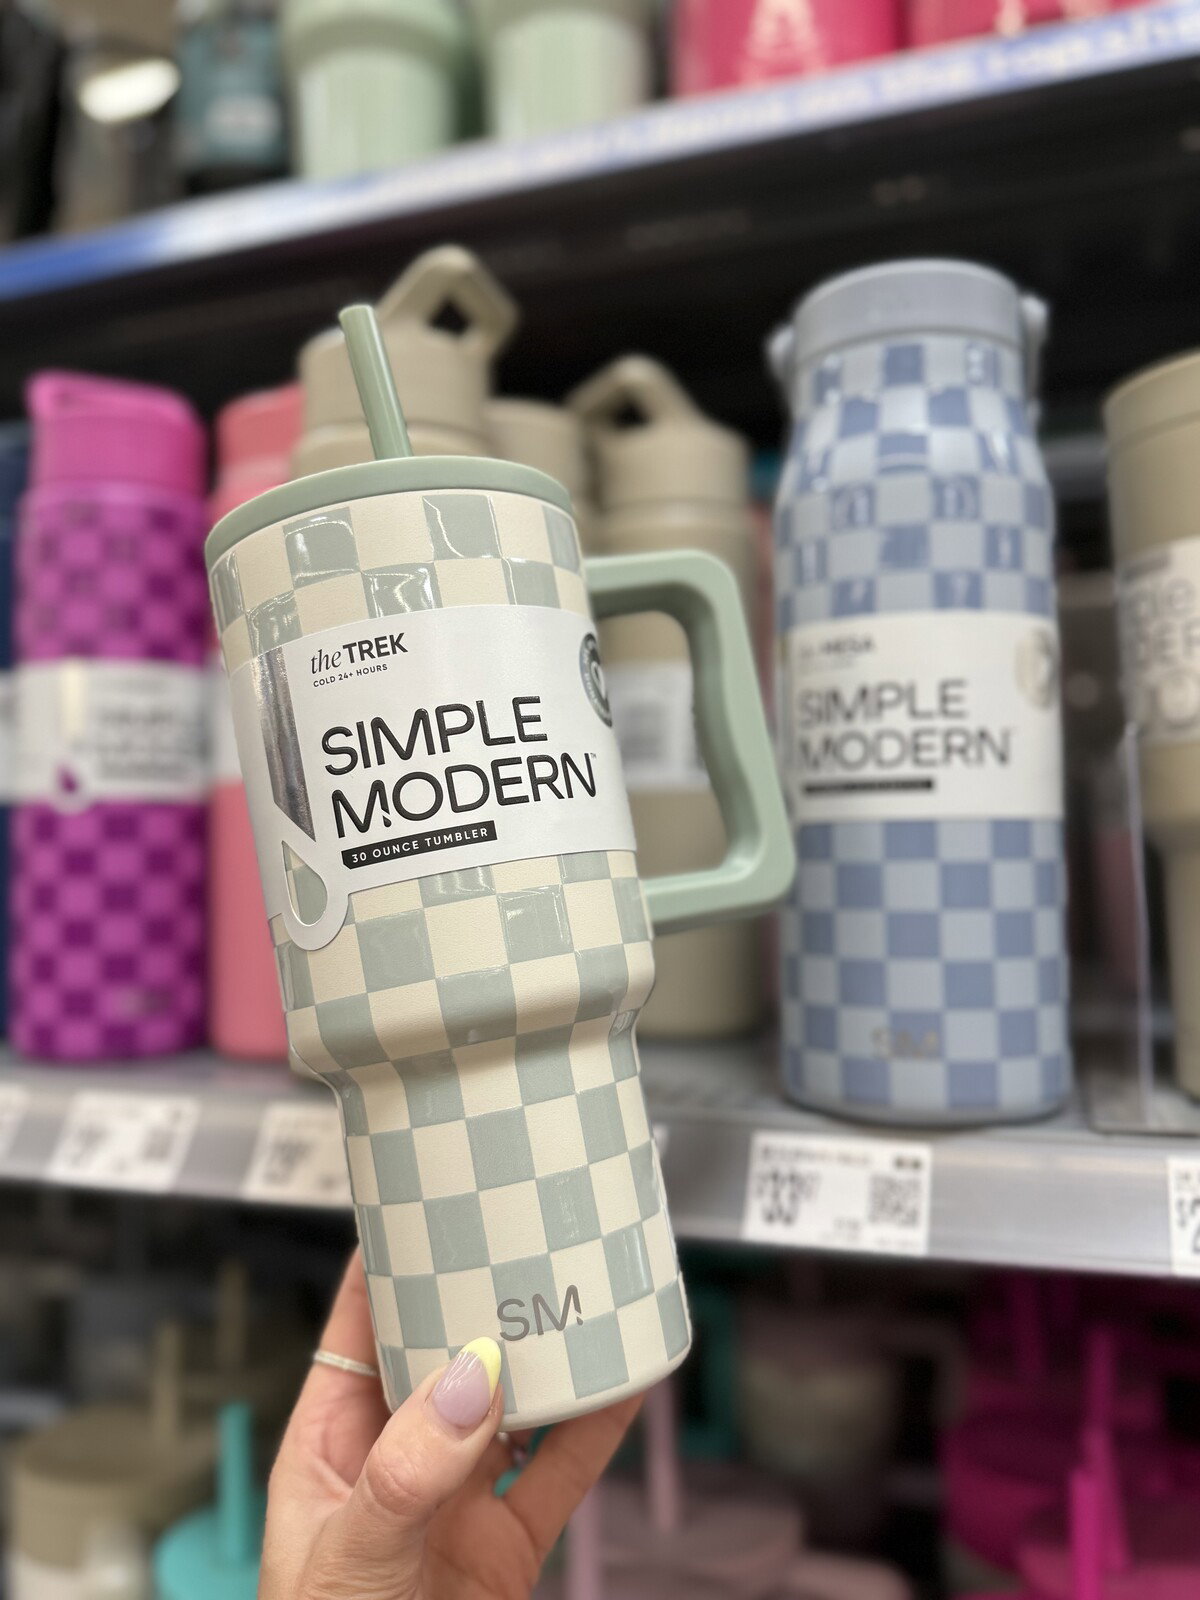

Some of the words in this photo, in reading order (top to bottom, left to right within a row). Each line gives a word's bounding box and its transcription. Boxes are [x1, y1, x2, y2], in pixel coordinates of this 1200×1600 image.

[311, 649, 342, 675] the
[343, 633, 408, 664] TREK
[313, 675, 336, 688] COLD
[338, 672, 353, 681] 24+
[356, 664, 388, 677] HOURS
[799, 678, 968, 729] SIMPLE
[321, 695, 548, 776] SIMPLE
[799, 725, 1012, 771] MODERN
[352, 853, 367, 863] 30
[372, 841, 419, 858] OUNCE
[425, 827, 488, 847] TUMBLER
[497, 1284, 584, 1342] SM
